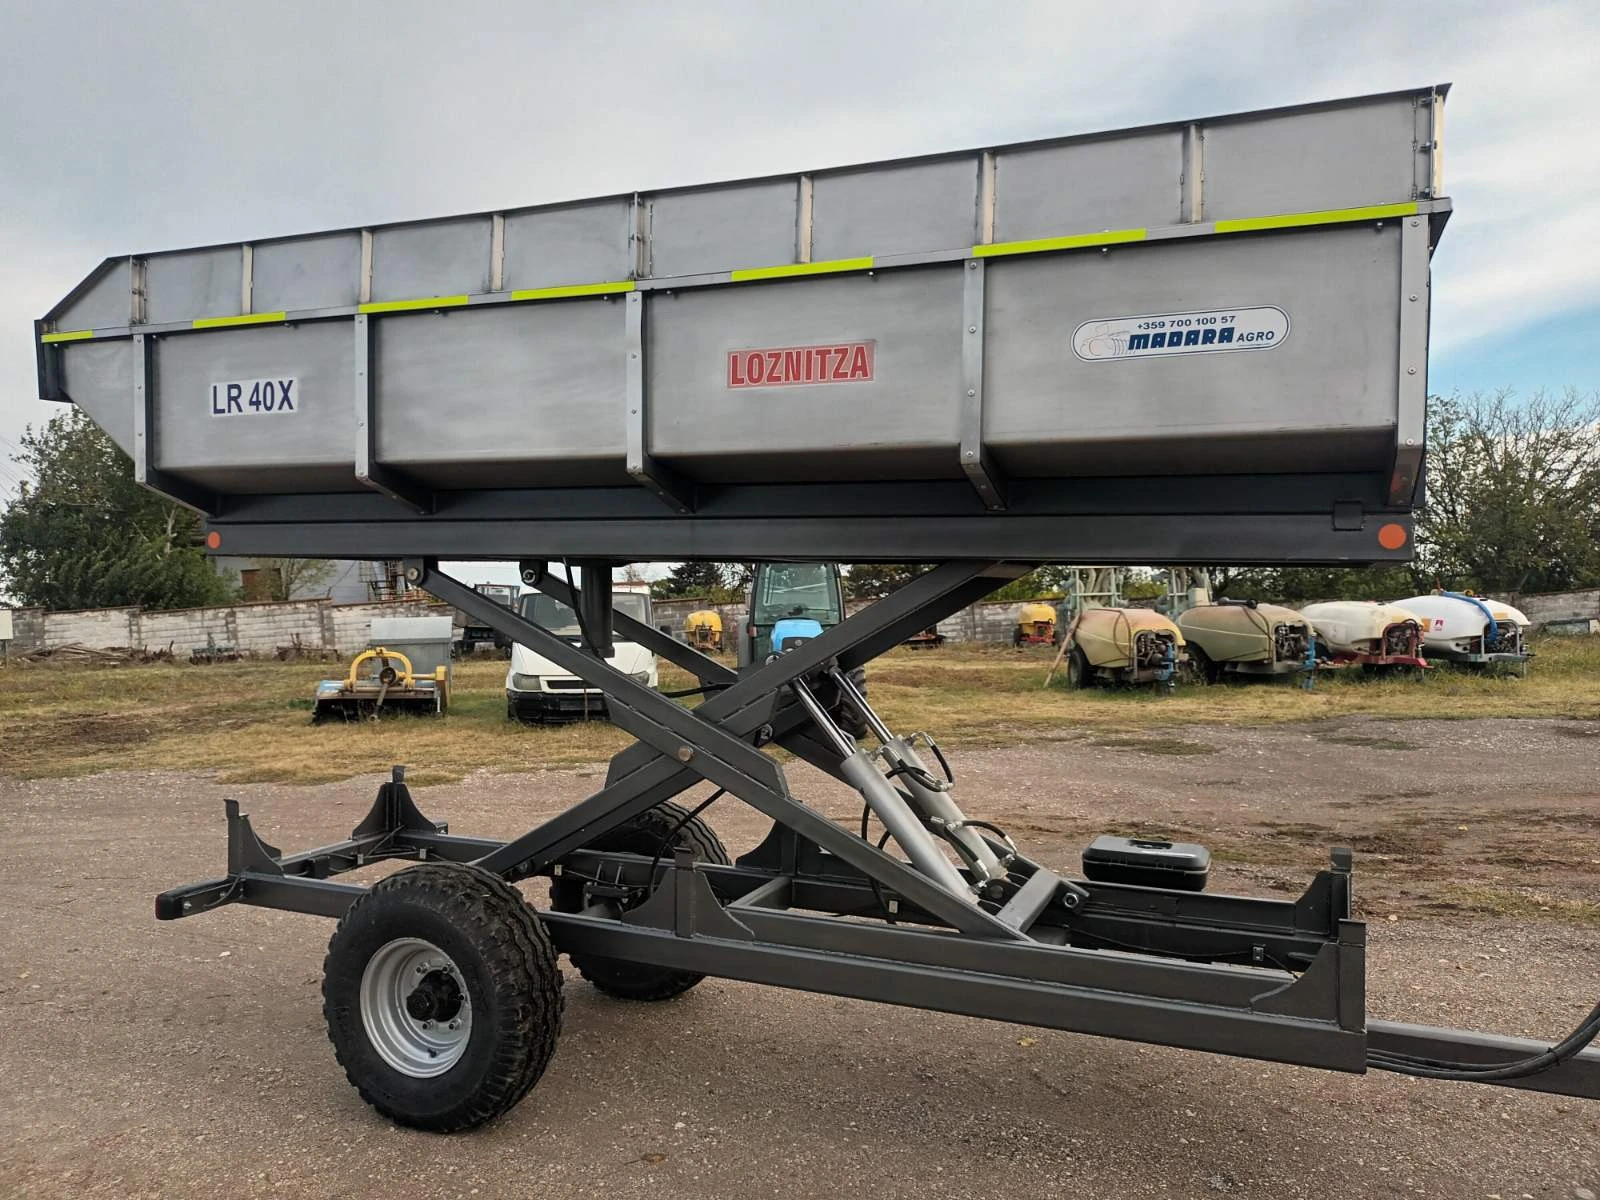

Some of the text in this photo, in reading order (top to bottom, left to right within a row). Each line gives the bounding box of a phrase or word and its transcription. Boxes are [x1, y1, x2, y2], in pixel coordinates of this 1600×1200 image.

[1137, 315, 1236, 330] +359 700 100 57
[1128, 326, 1275, 350] MADARA AGRO
[731, 346, 869, 385] LOZNITZA
[213, 383, 243, 415] LR
